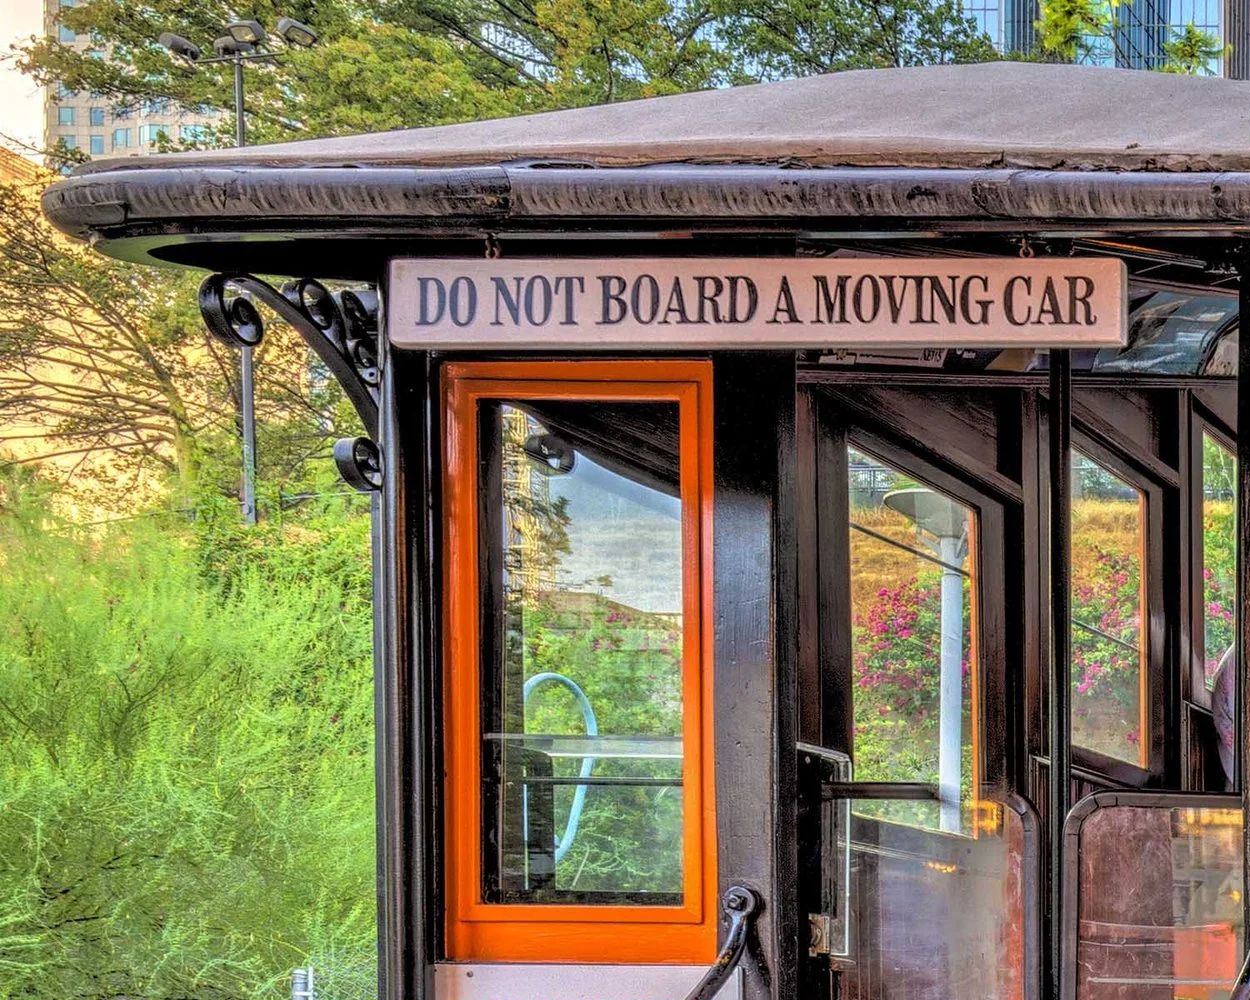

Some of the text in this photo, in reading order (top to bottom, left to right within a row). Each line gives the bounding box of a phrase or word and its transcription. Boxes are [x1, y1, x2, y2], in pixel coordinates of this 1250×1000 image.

[415, 274, 1098, 327] DO NOT BOARD A MOVING CAR
